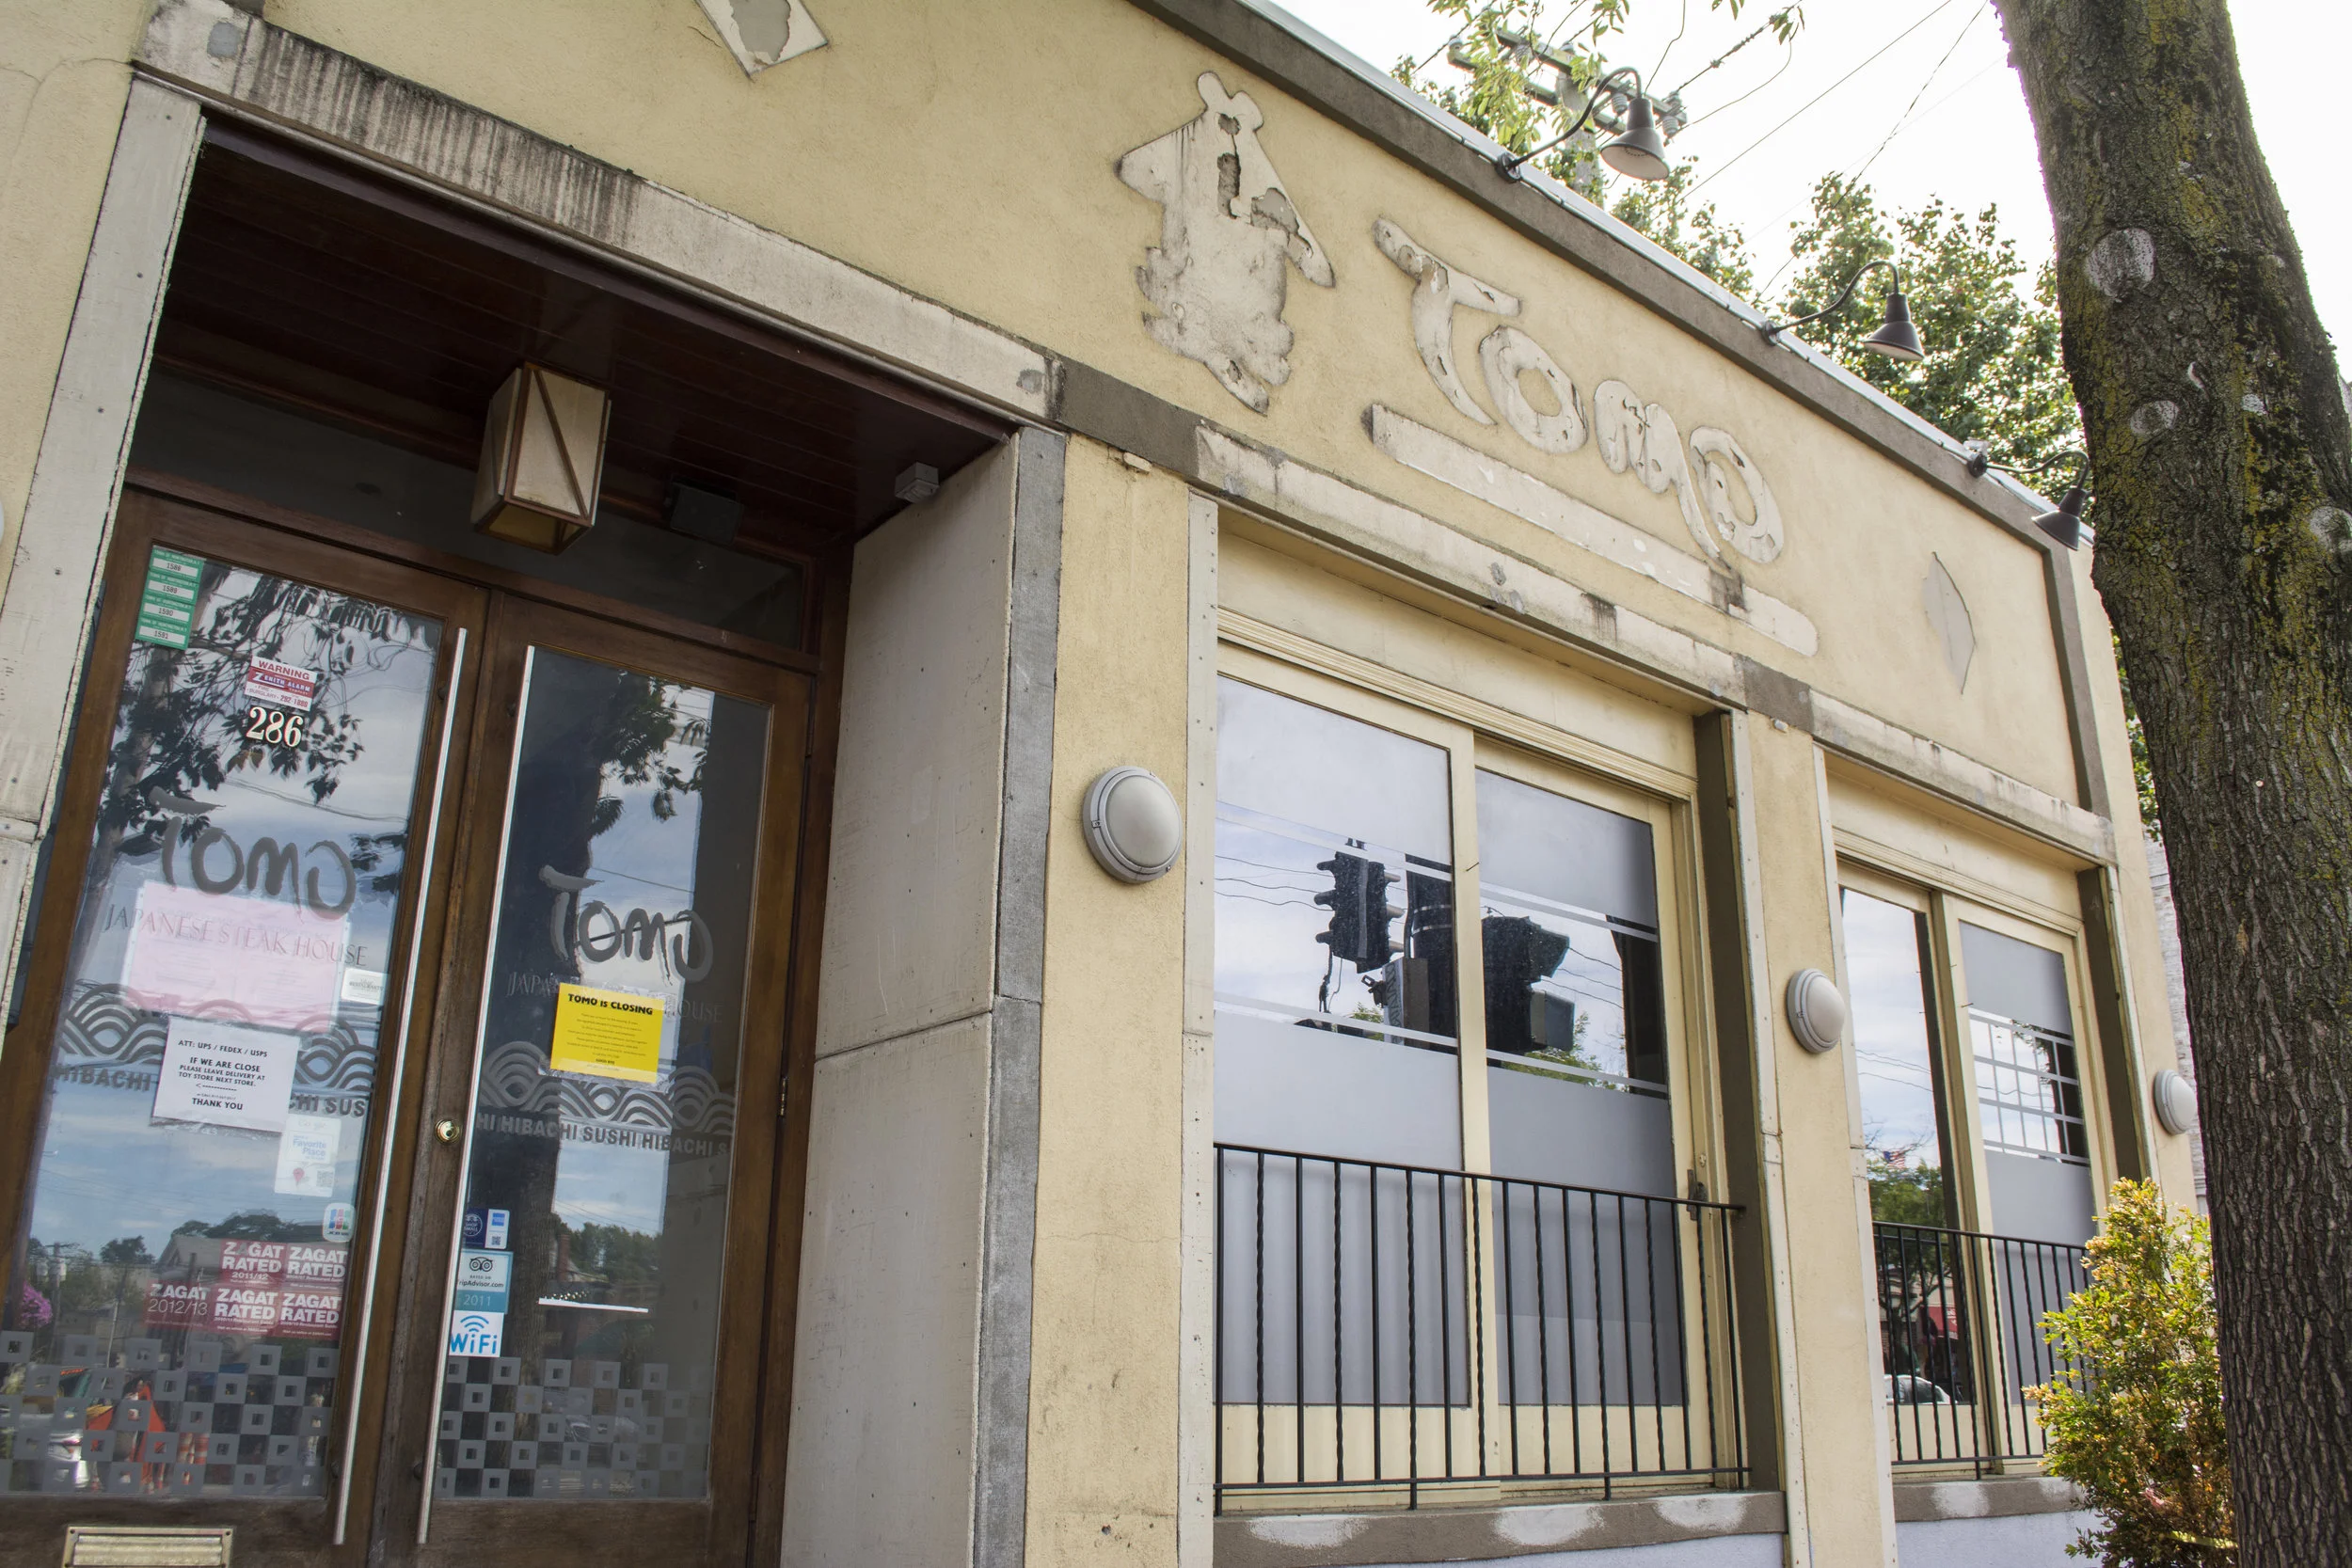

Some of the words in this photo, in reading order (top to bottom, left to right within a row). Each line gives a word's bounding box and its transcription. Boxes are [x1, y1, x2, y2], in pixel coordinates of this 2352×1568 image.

[259, 660, 310, 680] WARNING
[252, 672, 285, 687] ZENITH
[287, 681, 310, 692] ALARM
[246, 706, 304, 747] 286
[103, 904, 214, 942] JAPANESE
[295, 935, 369, 967] HOUSE
[568, 993, 597, 1006] TOMO
[611, 1001, 653, 1015] CLOSING
[178, 1039, 196, 1048] ATT:
[198, 1041, 212, 1050] UPS
[219, 1045, 242, 1054] FEDEX
[250, 1049, 268, 1057] USPS
[215, 1060, 231, 1069] ARE
[234, 1063, 261, 1072] CLOSE
[226, 1070, 255, 1080] DELIVERY
[192, 1098, 222, 1108] THANK
[224, 1101, 244, 1110] YOU
[500, 1115, 578, 1140] HIBACHI
[582, 1126, 637, 1148] SUSHI
[643, 1133, 713, 1156] HIBACHI
[223, 1241, 284, 1259] ZAGAT
[289, 1246, 347, 1263] ZAGAT
[221, 1256, 282, 1274] RATED
[287, 1260, 345, 1278] RATED
[150, 1283, 212, 1301] ZAGAT
[457, 1279, 504, 1288] ripAdvisor.com
[216, 1288, 278, 1306] ZAGAT
[282, 1292, 342, 1309] ZAGAT
[463, 1294, 491, 1307] 2011
[148, 1298, 208, 1316] 2012/13
[215, 1303, 276, 1321] RATED
[280, 1307, 340, 1324] RATED
[450, 1333, 497, 1354] WiFi
